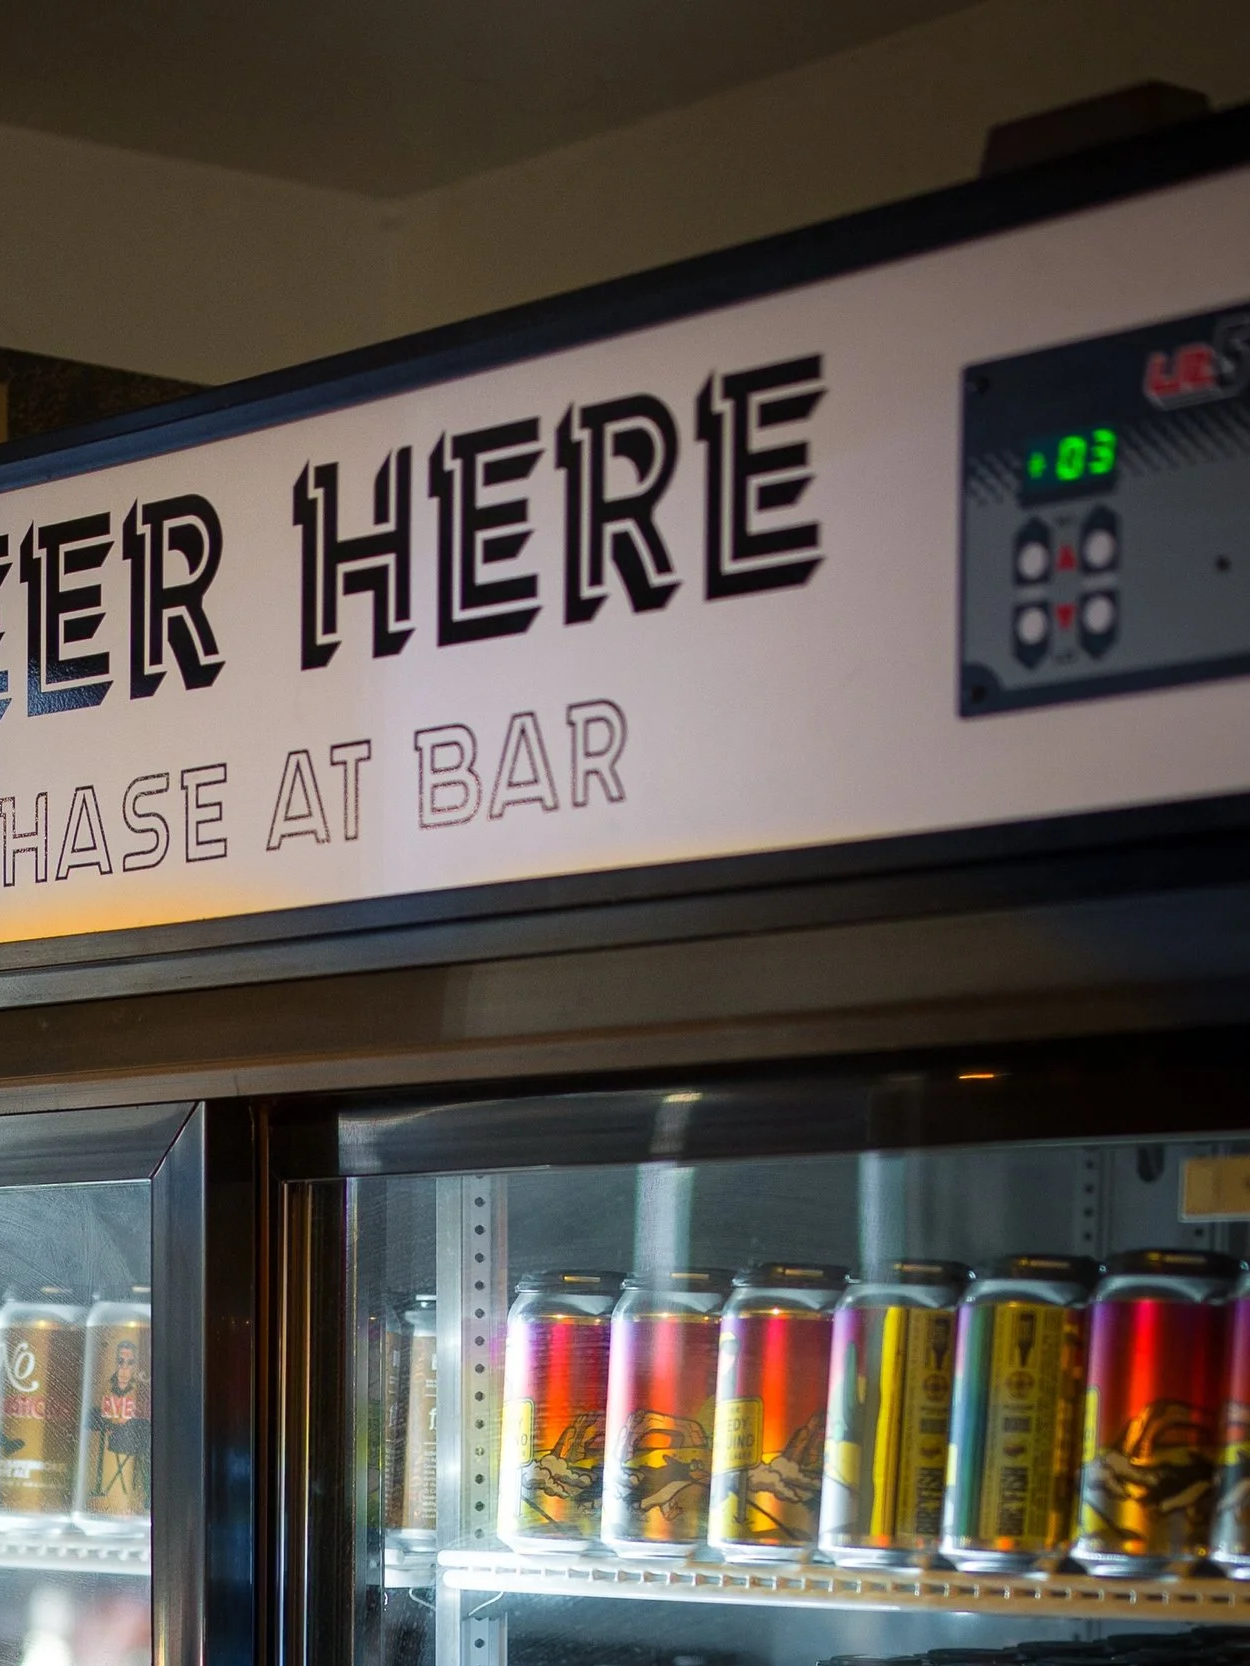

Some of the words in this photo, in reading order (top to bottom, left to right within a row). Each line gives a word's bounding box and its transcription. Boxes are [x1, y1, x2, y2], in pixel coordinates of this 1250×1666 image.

[292, 354, 828, 671] HERE
[266, 739, 372, 851] AT
[413, 697, 627, 830] BAR
